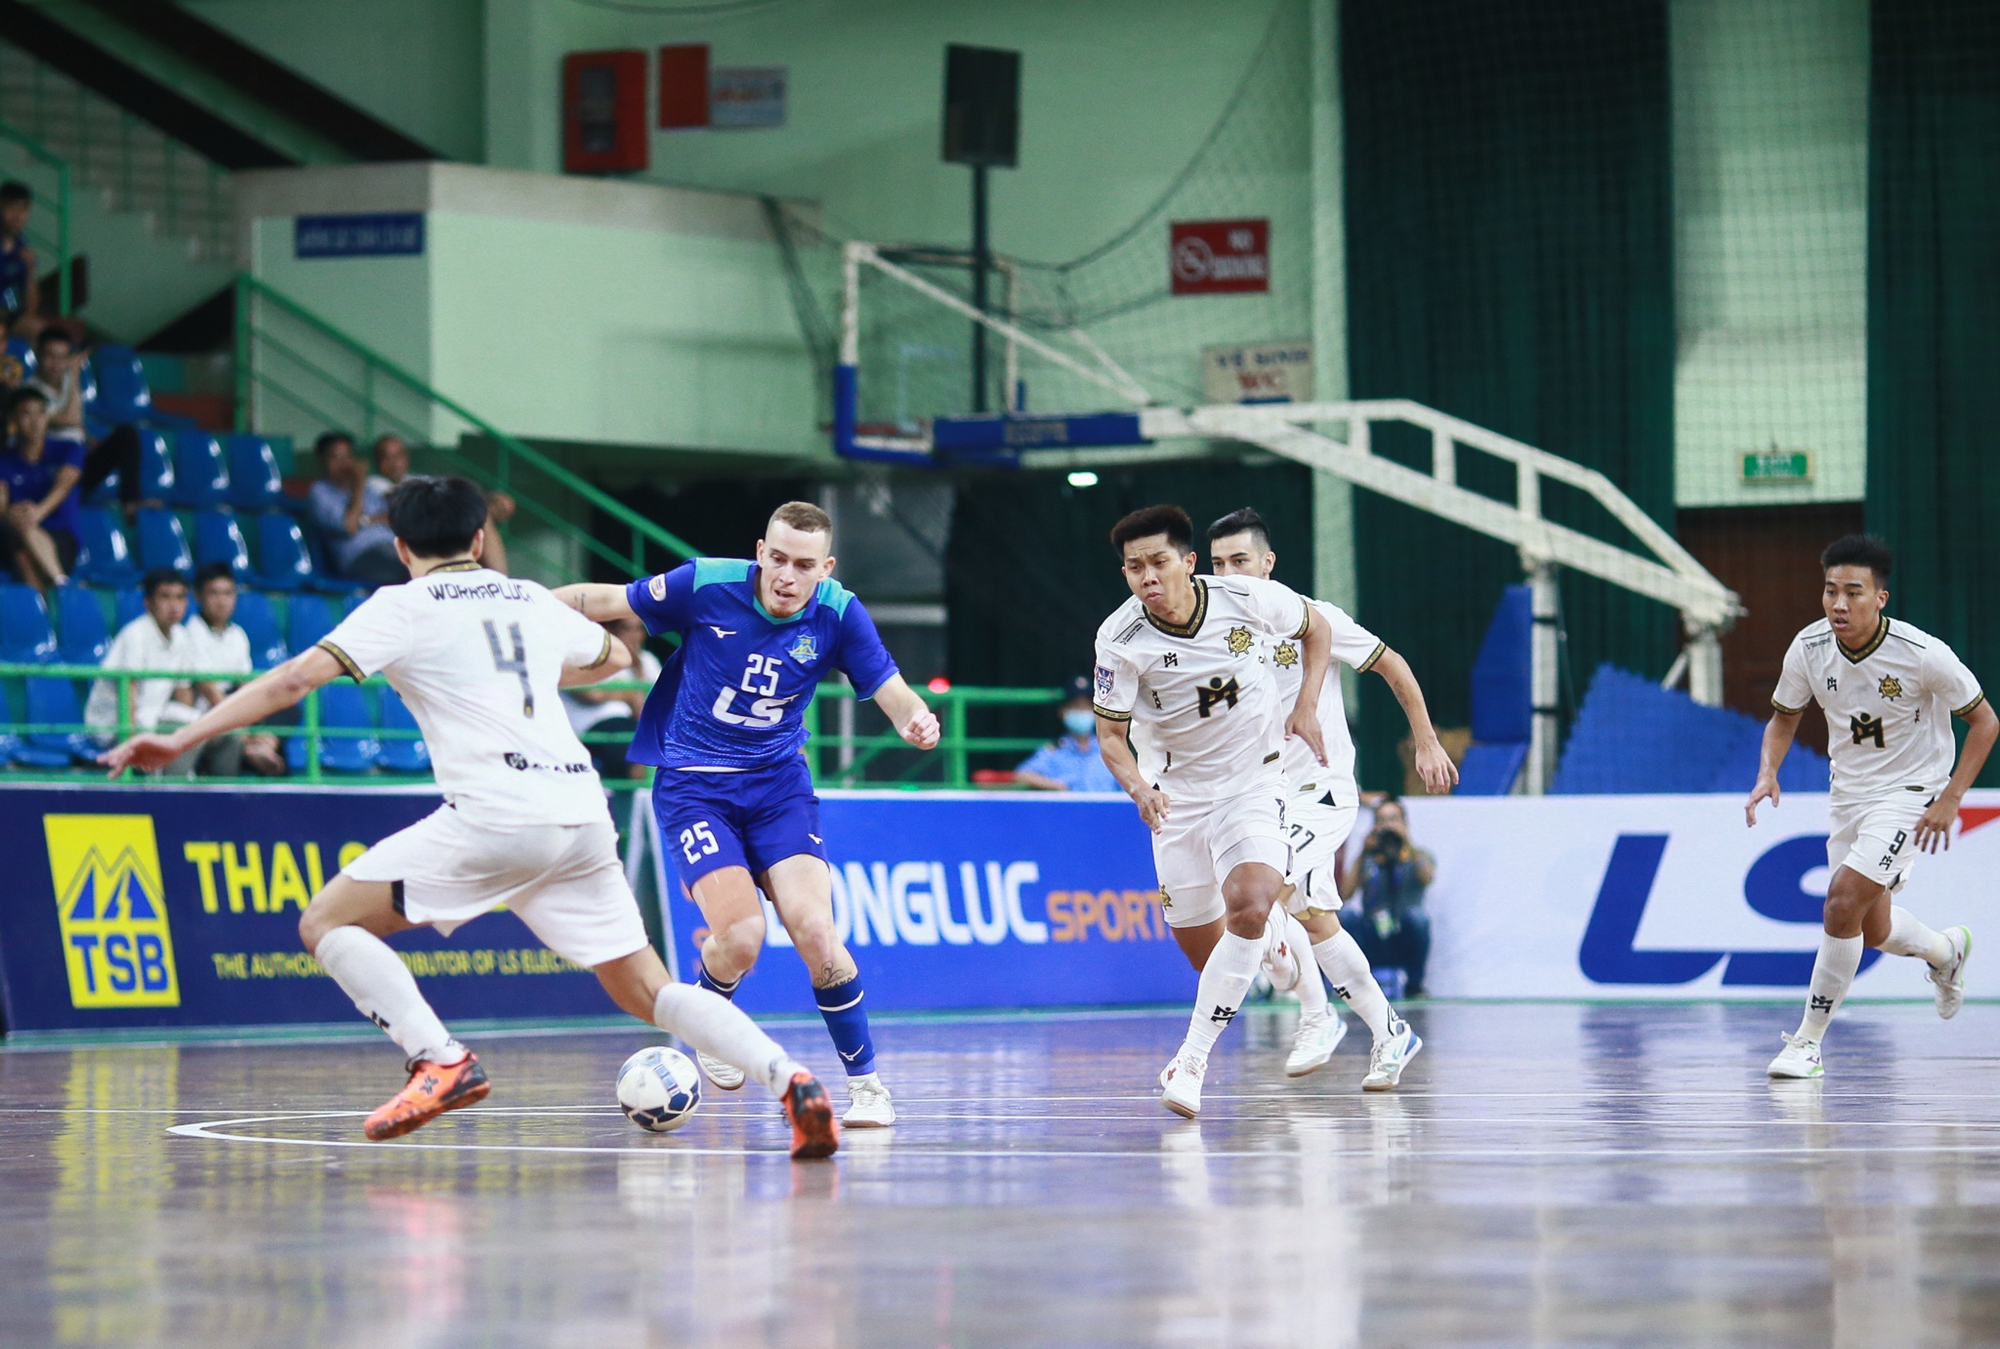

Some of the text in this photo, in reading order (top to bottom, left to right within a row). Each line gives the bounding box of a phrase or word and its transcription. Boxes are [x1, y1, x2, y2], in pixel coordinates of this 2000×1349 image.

[481, 619, 534, 719] 4
[741, 653, 784, 697] 25
[712, 685, 799, 728] LS
[679, 820, 720, 865] 25
[1289, 822, 1316, 854] 77
[1888, 829, 1908, 856] 9
[761, 860, 1175, 947] NGLUC SPORT
[1578, 831, 1886, 986] LS
[71, 933, 168, 993] TSB
[212, 952, 249, 979] THE
[251, 951, 333, 978] AUTHOR
[472, 949, 496, 975] OF
[497, 949, 520, 975] LS
